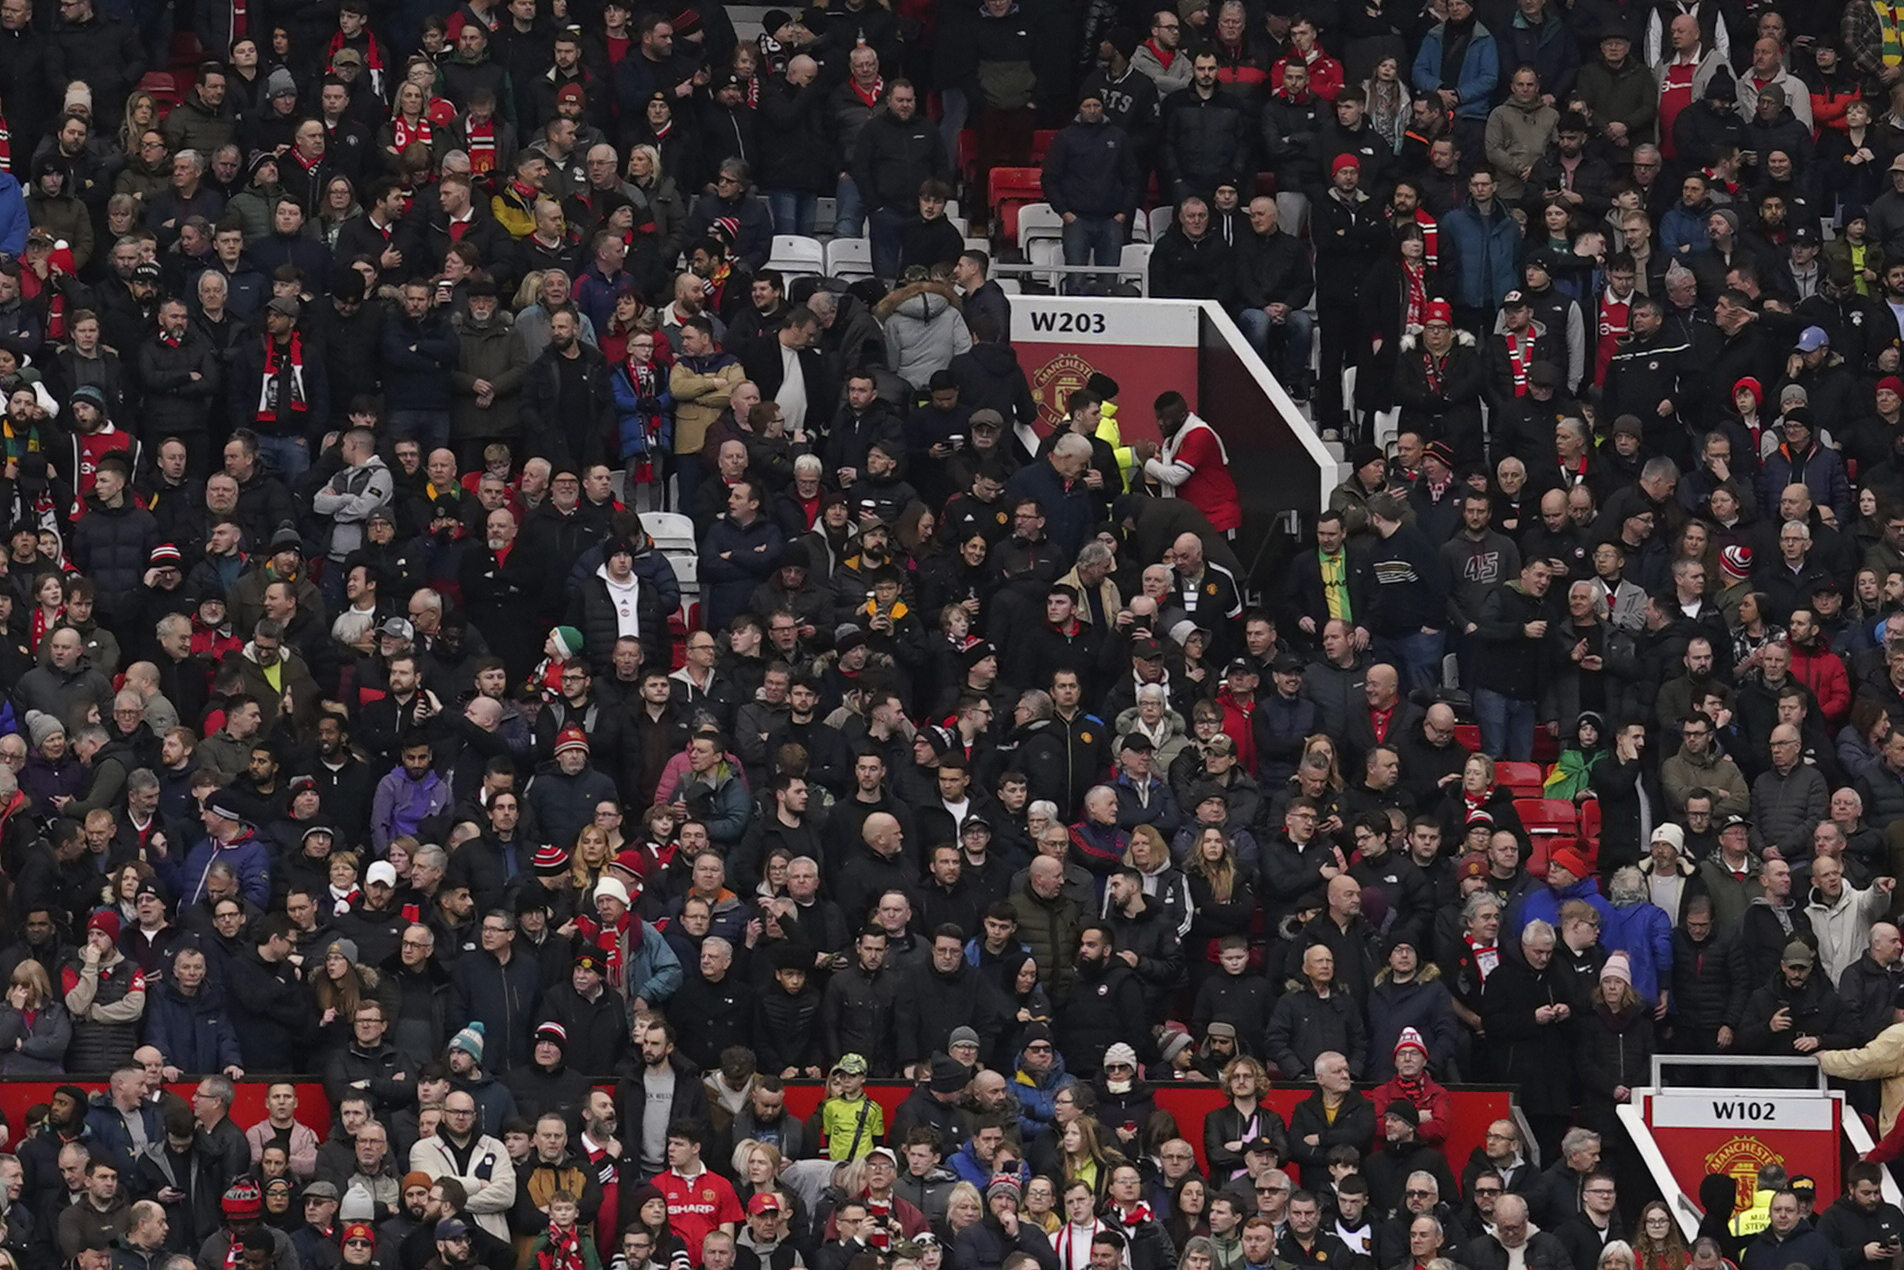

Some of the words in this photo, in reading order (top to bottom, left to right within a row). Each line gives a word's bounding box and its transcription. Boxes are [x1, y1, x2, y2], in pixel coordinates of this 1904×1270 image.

[1031, 311, 1106, 334] W203
[1712, 1101, 1775, 1121] W102
[1711, 1142, 1774, 1172] MANCHESTE
[667, 1205, 716, 1215] SHARP
